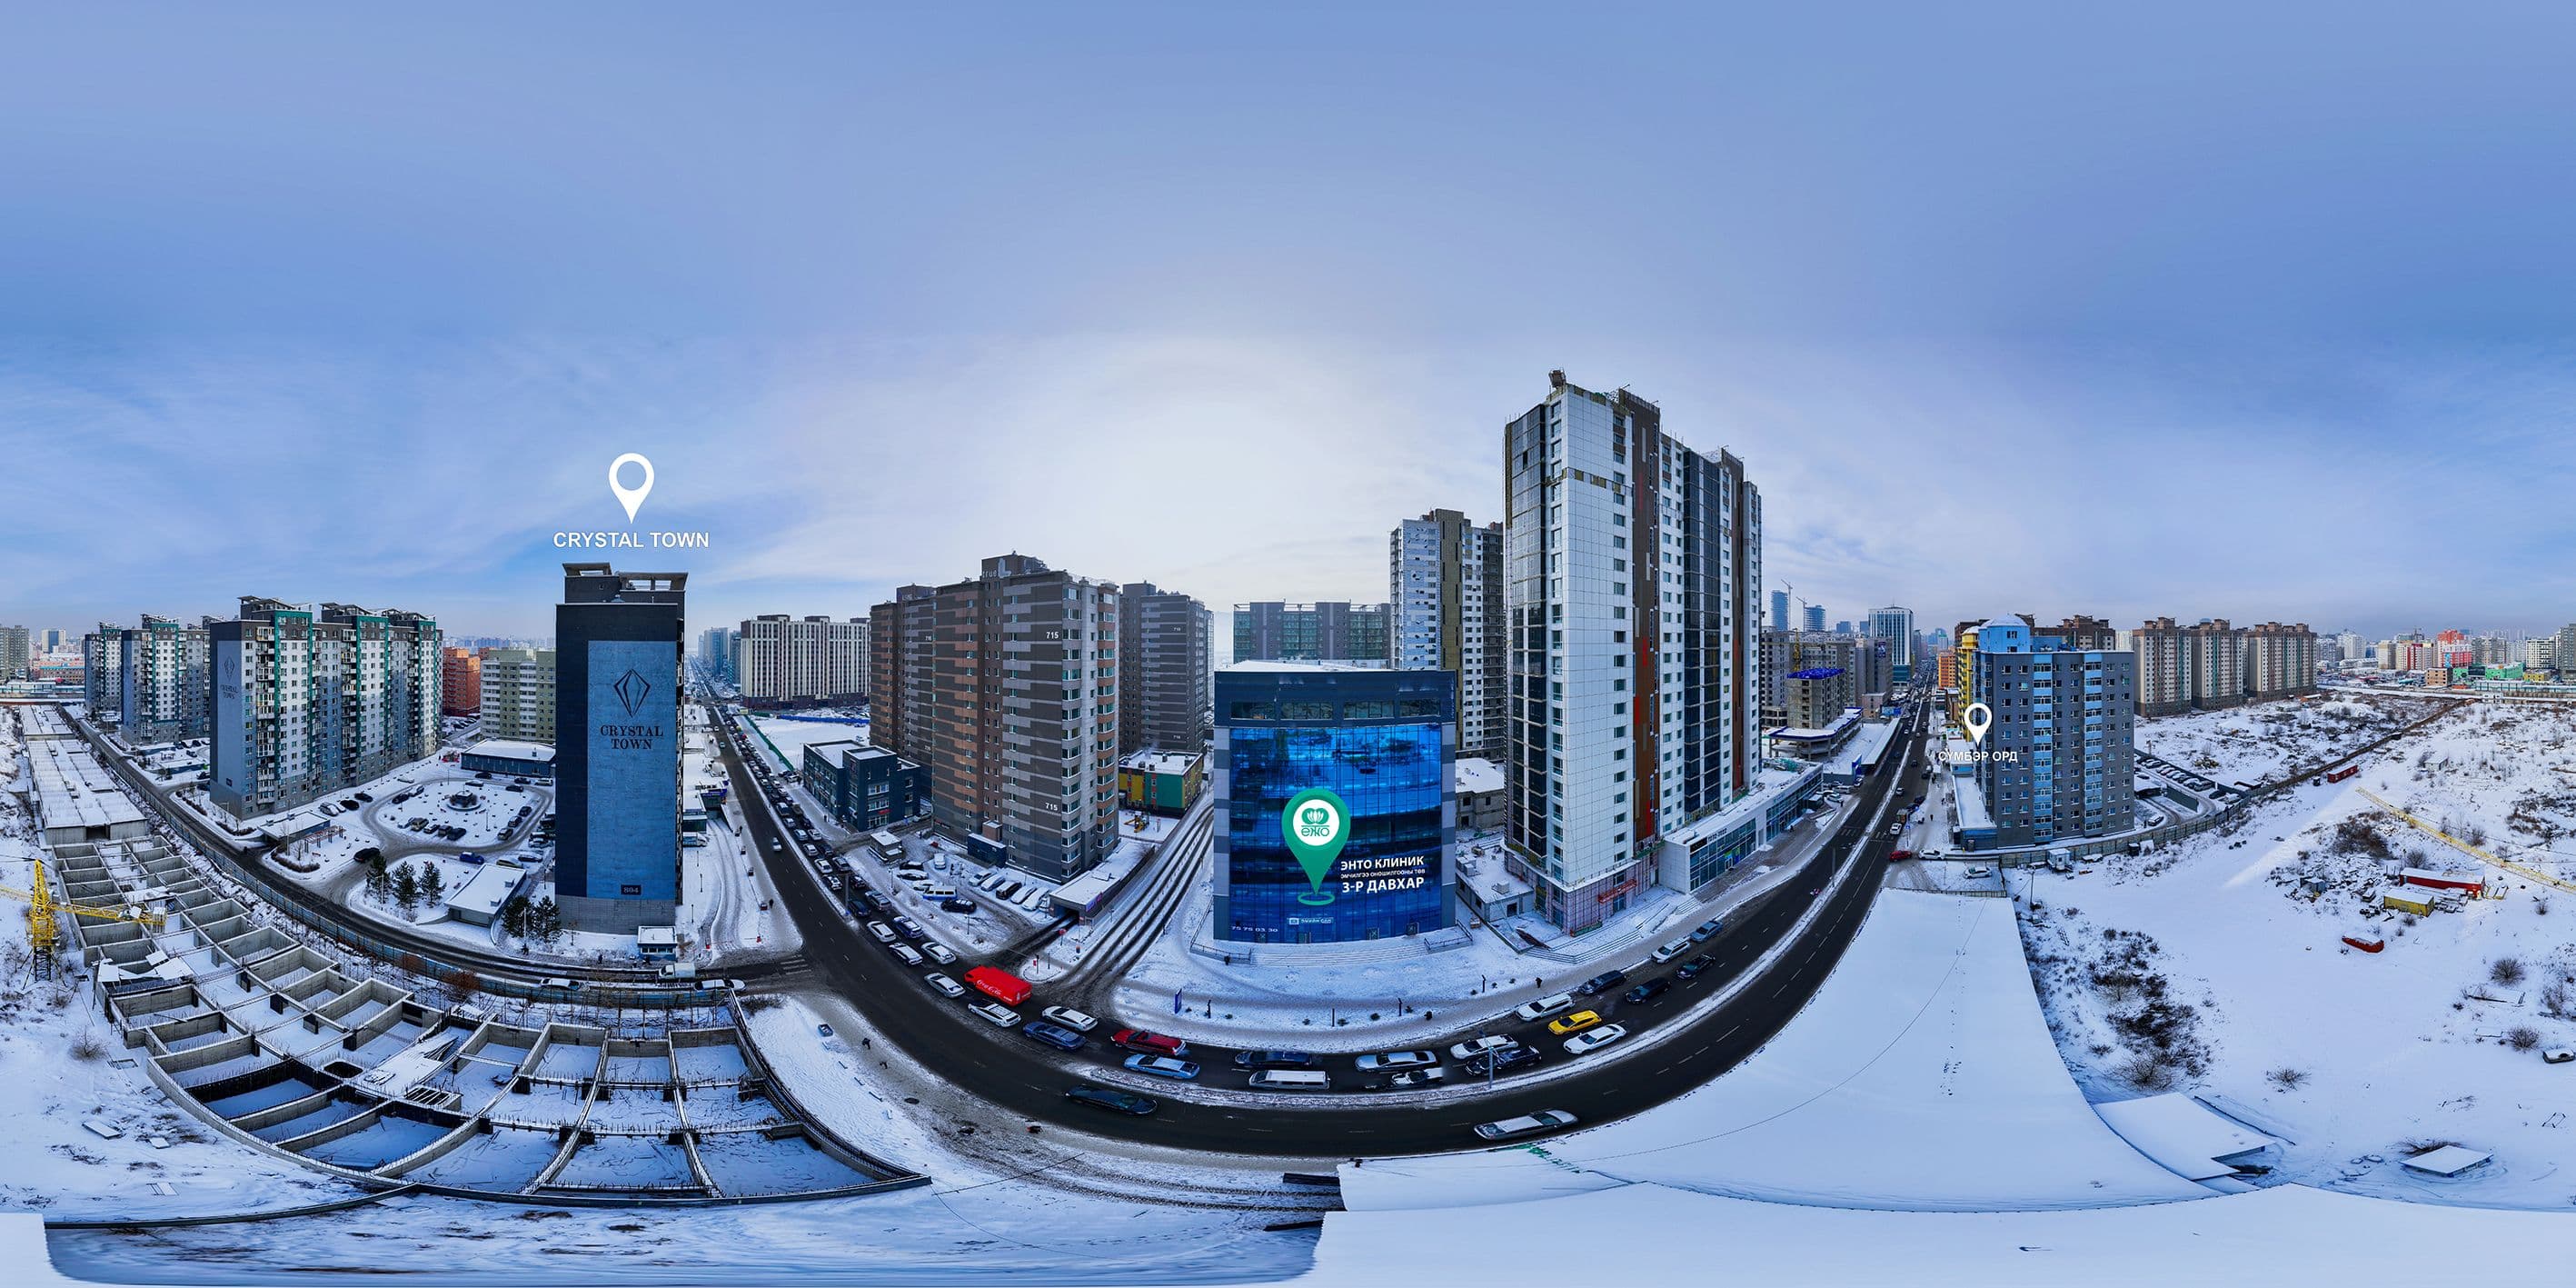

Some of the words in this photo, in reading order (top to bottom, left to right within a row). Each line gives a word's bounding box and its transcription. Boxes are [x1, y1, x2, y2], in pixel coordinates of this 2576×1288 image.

[1046, 631, 1059, 639] 715
[600, 725, 663, 737] CRYSTAL
[611, 738, 652, 750] TOWN
[1045, 802, 1058, 811] 715
